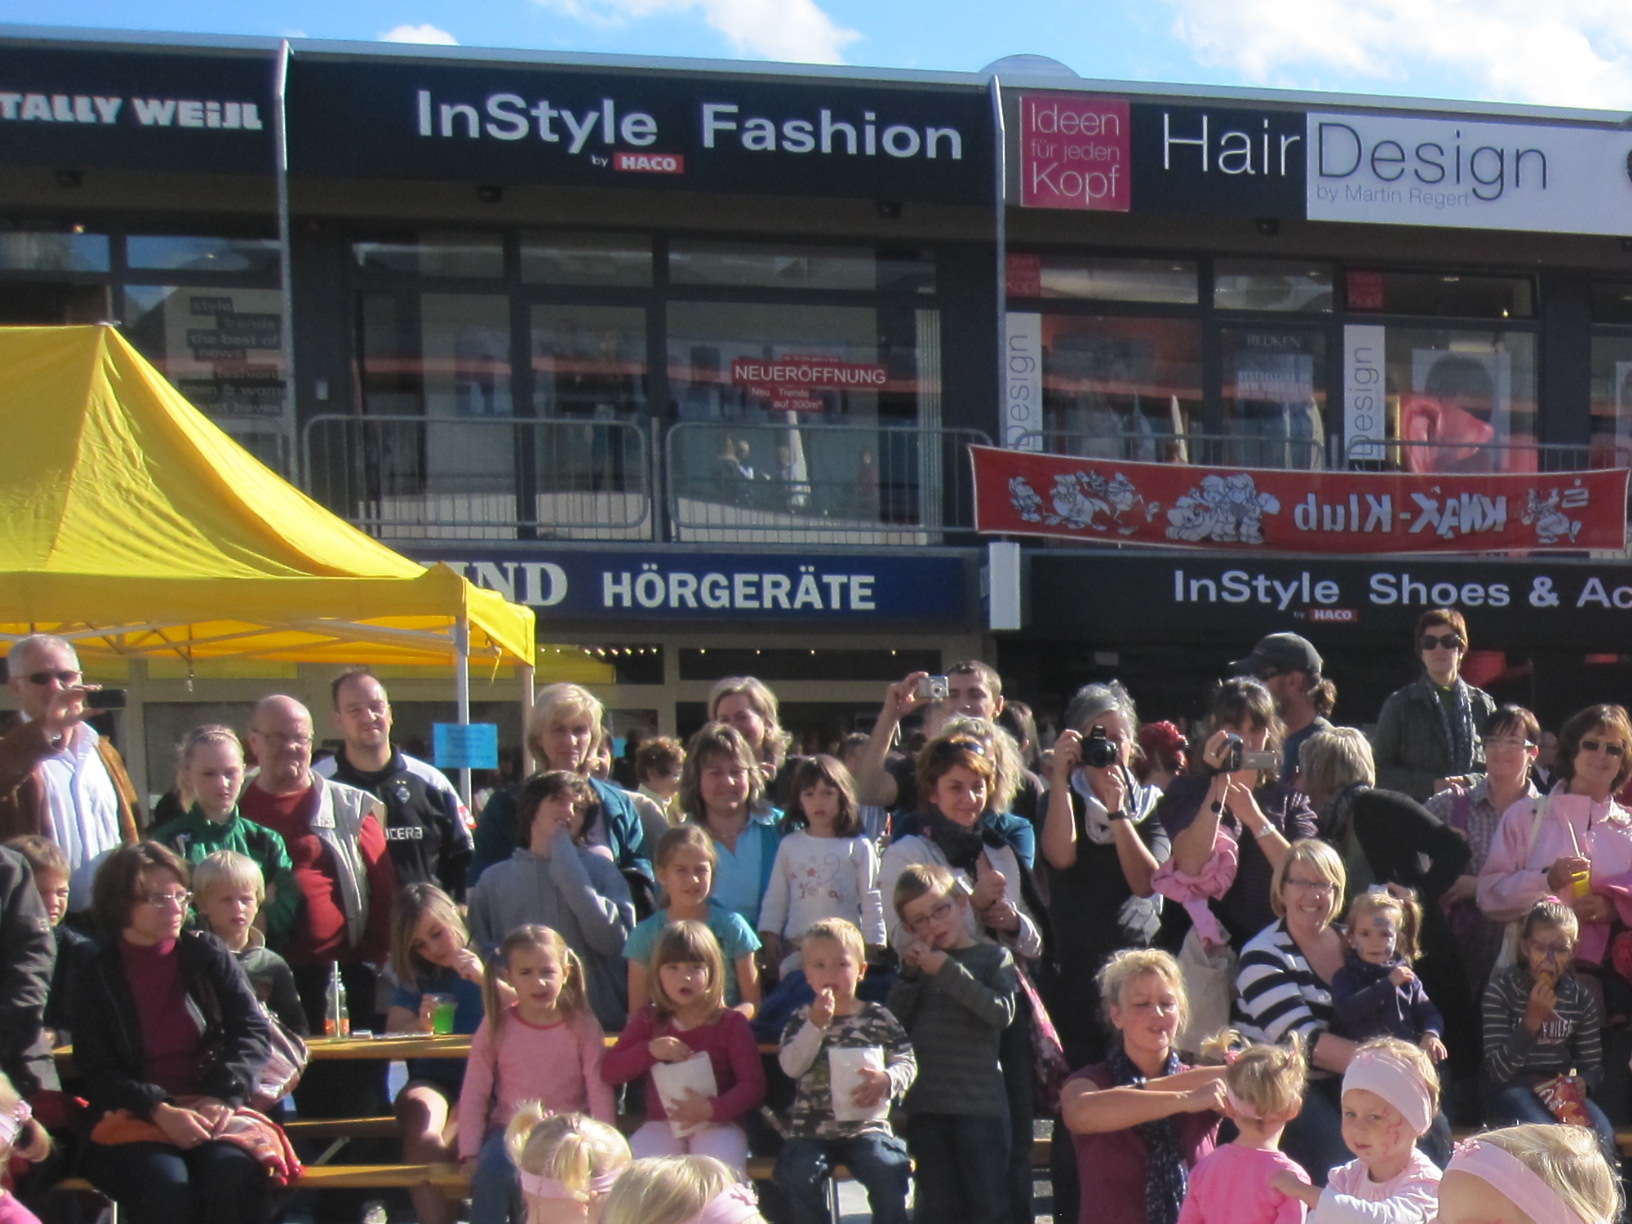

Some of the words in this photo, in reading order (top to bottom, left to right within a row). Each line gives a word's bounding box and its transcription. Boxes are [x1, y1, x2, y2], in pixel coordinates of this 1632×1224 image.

[0, 92, 122, 124] TALLY
[1031, 103, 1120, 136] Ideen
[418, 90, 659, 154] InStyle
[702, 103, 962, 160] Fashion
[590, 154, 609, 168] by
[620, 155, 677, 172] HACO
[1031, 138, 1055, 158] für
[1062, 141, 1120, 163] jeden
[1163, 112, 1301, 176] Hair
[1318, 122, 1547, 201] Design
[1032, 161, 1120, 205] Kopf
[1316, 184, 1339, 203] by
[1345, 184, 1402, 202] Martin
[1409, 187, 1470, 210] Regert
[735, 364, 887, 384] NEUERÖFFNUNG
[602, 563, 876, 610] HÖRGERÄTE
[1174, 570, 1340, 610] InStyle
[1369, 573, 1511, 608] Shoes
[1529, 576, 1560, 608] &
[1313, 609, 1353, 621] HACO
